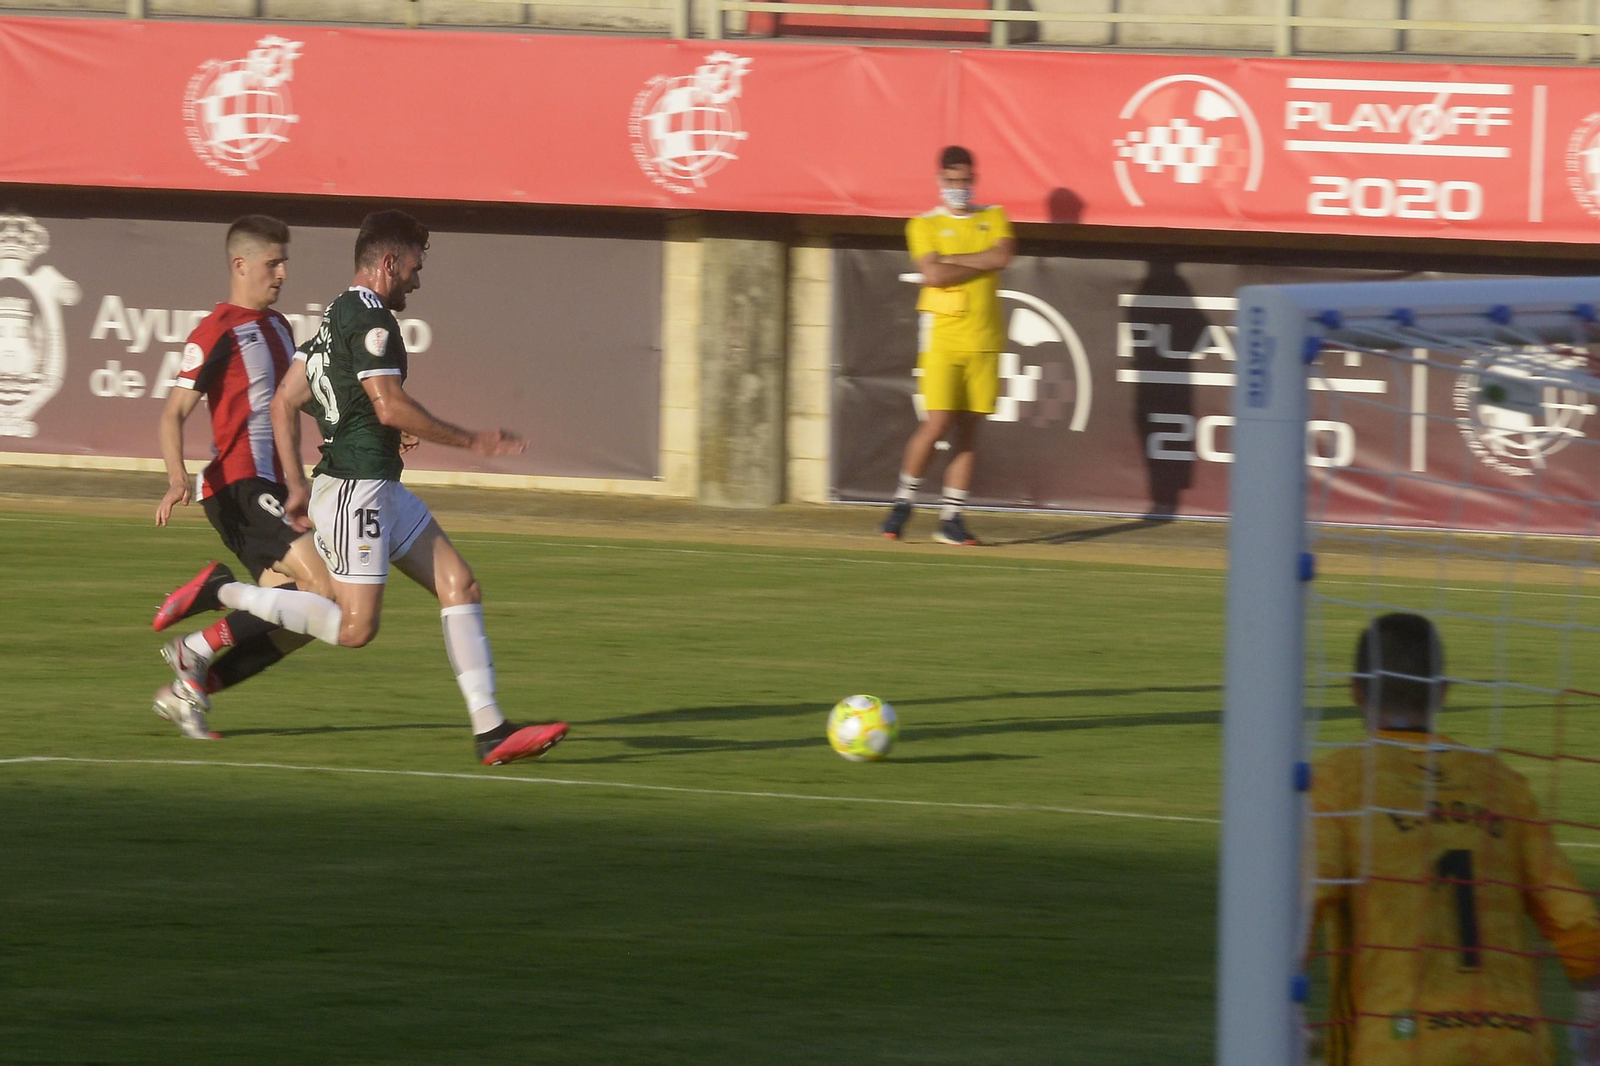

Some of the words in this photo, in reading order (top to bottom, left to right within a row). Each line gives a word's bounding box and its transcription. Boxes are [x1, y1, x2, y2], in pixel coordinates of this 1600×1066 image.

[1307, 175, 1483, 221] 2020
[88, 360, 147, 398] de
[353, 507, 382, 539] 15
[1434, 848, 1481, 968] 1
